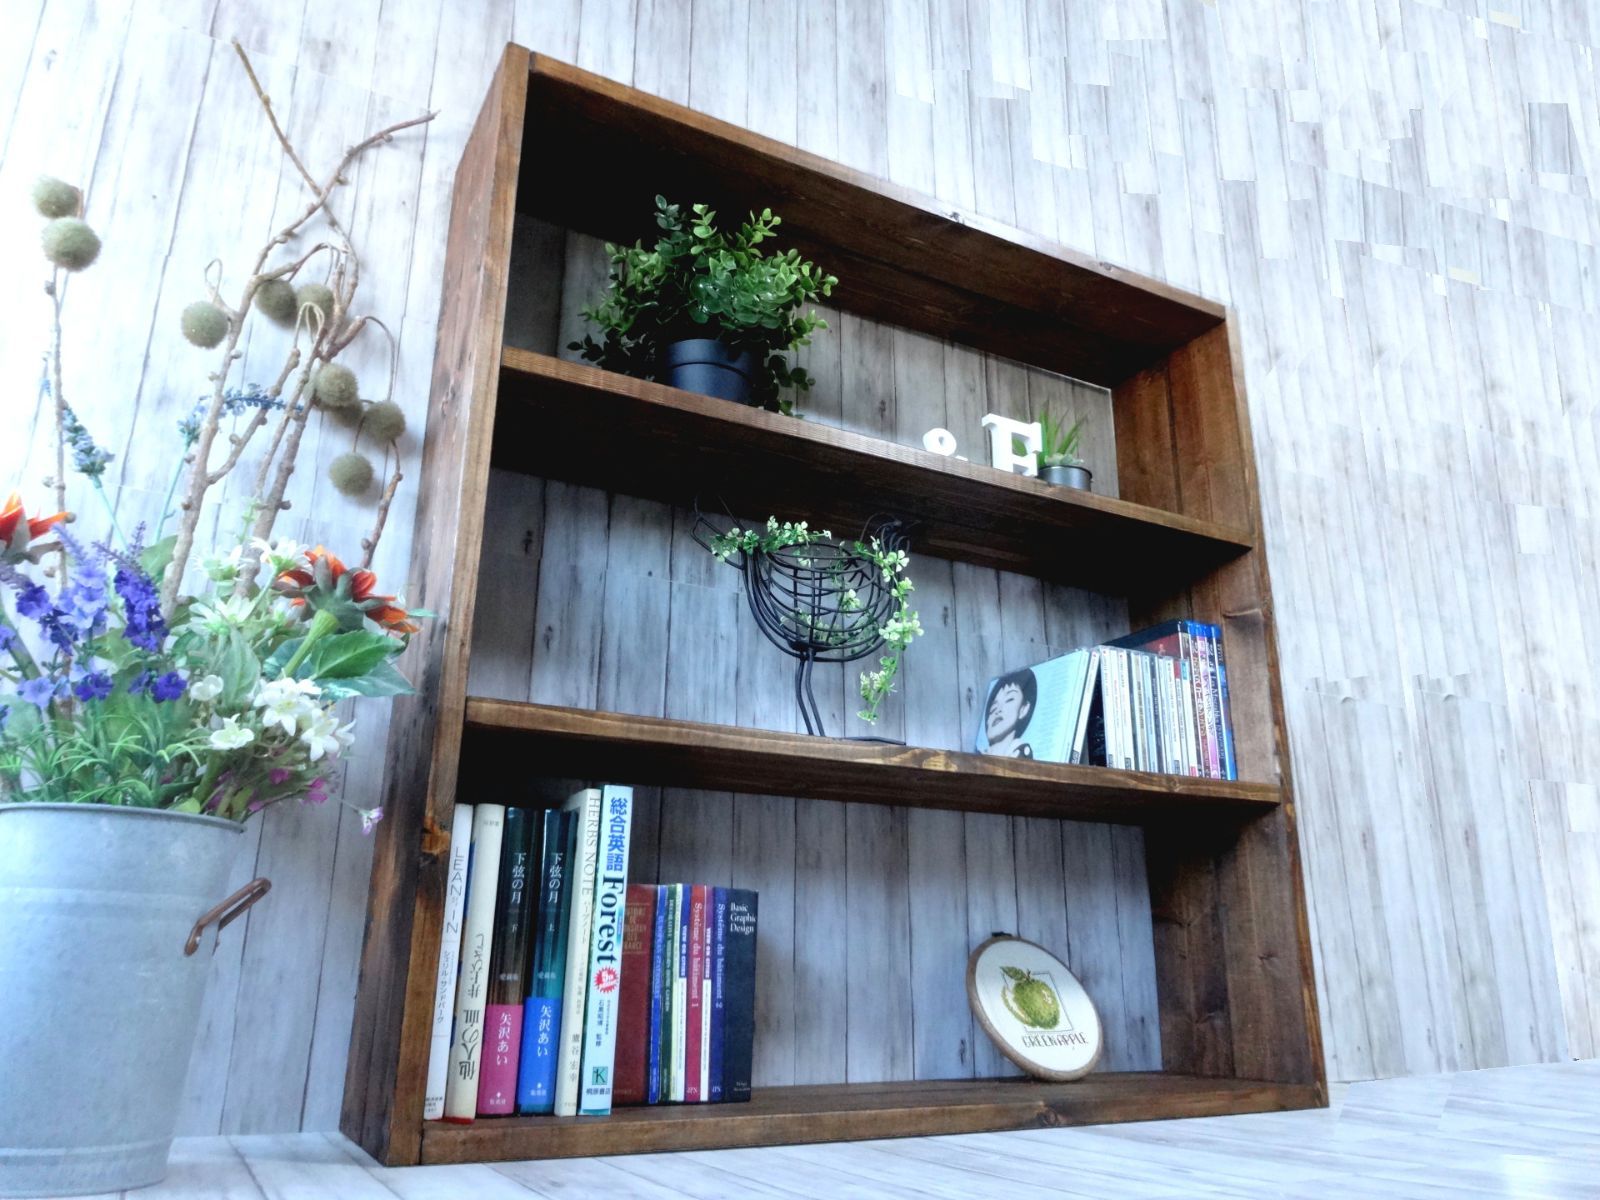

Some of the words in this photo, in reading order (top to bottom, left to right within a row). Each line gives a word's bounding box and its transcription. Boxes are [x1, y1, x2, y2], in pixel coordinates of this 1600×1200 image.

[585, 797, 601, 848] HERBS
[606, 796, 628, 872] 総合英語
[450, 847, 465, 896] LEAN
[511, 852, 527, 904] 下弦の月
[548, 852, 563, 904] 下弦の月
[581, 852, 596, 896] NOTE
[447, 910, 459, 934] IN
[596, 874, 625, 965] Forest
[730, 902, 748, 912] Basic
[730, 922, 754, 935] Design
[693, 943, 701, 955] du
[717, 943, 724, 955] du
[458, 1009, 480, 1081] 他人の血
[496, 1011, 512, 1066] 矢沢あい
[537, 1004, 552, 1058] 矢沢あい
